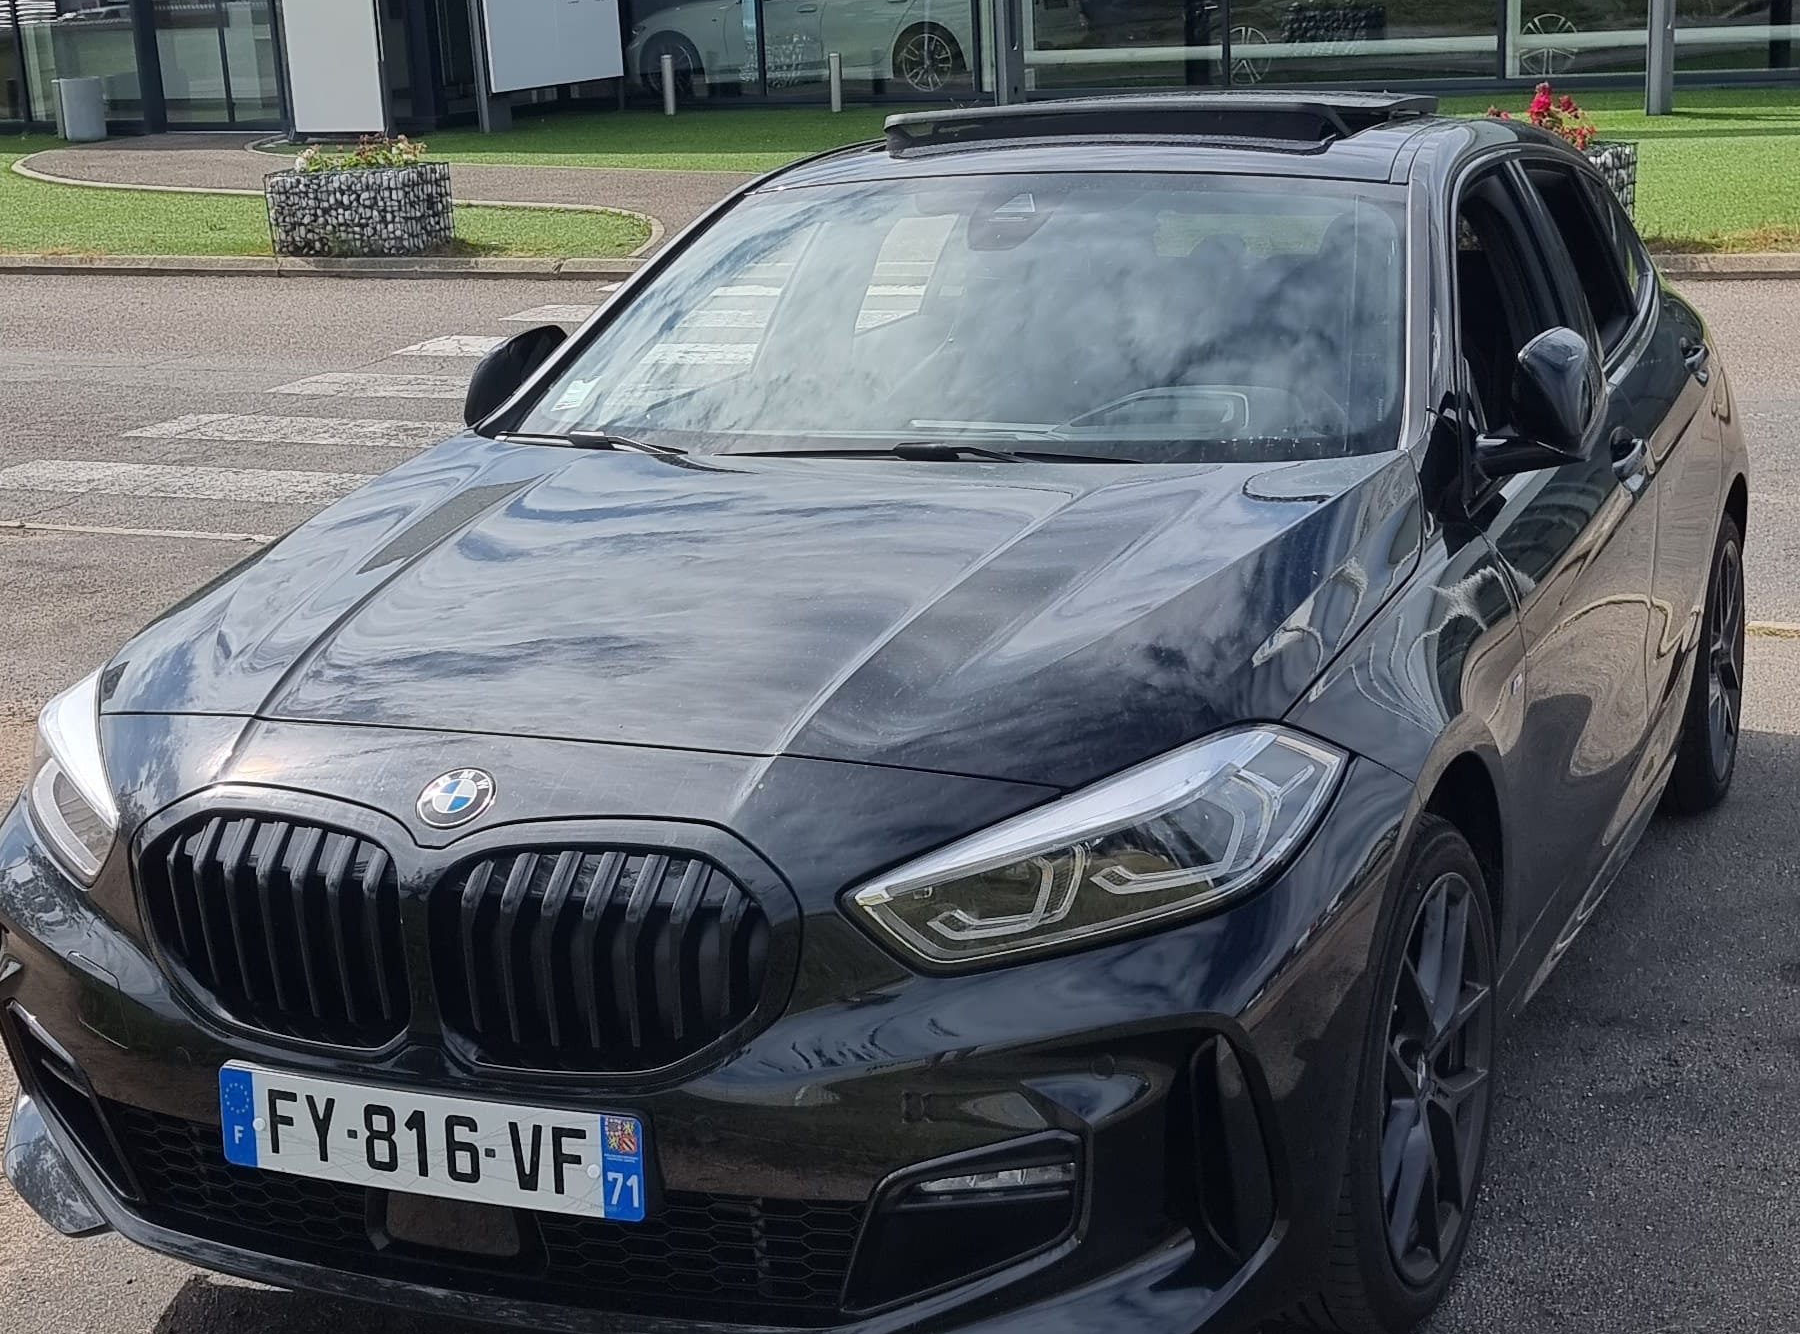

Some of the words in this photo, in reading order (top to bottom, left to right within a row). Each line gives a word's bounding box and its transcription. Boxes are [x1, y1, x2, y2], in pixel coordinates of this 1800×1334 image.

[233, 1125, 244, 1144] F
[267, 1088, 588, 1195] FY-816-VF
[607, 1171, 640, 1208] 71
